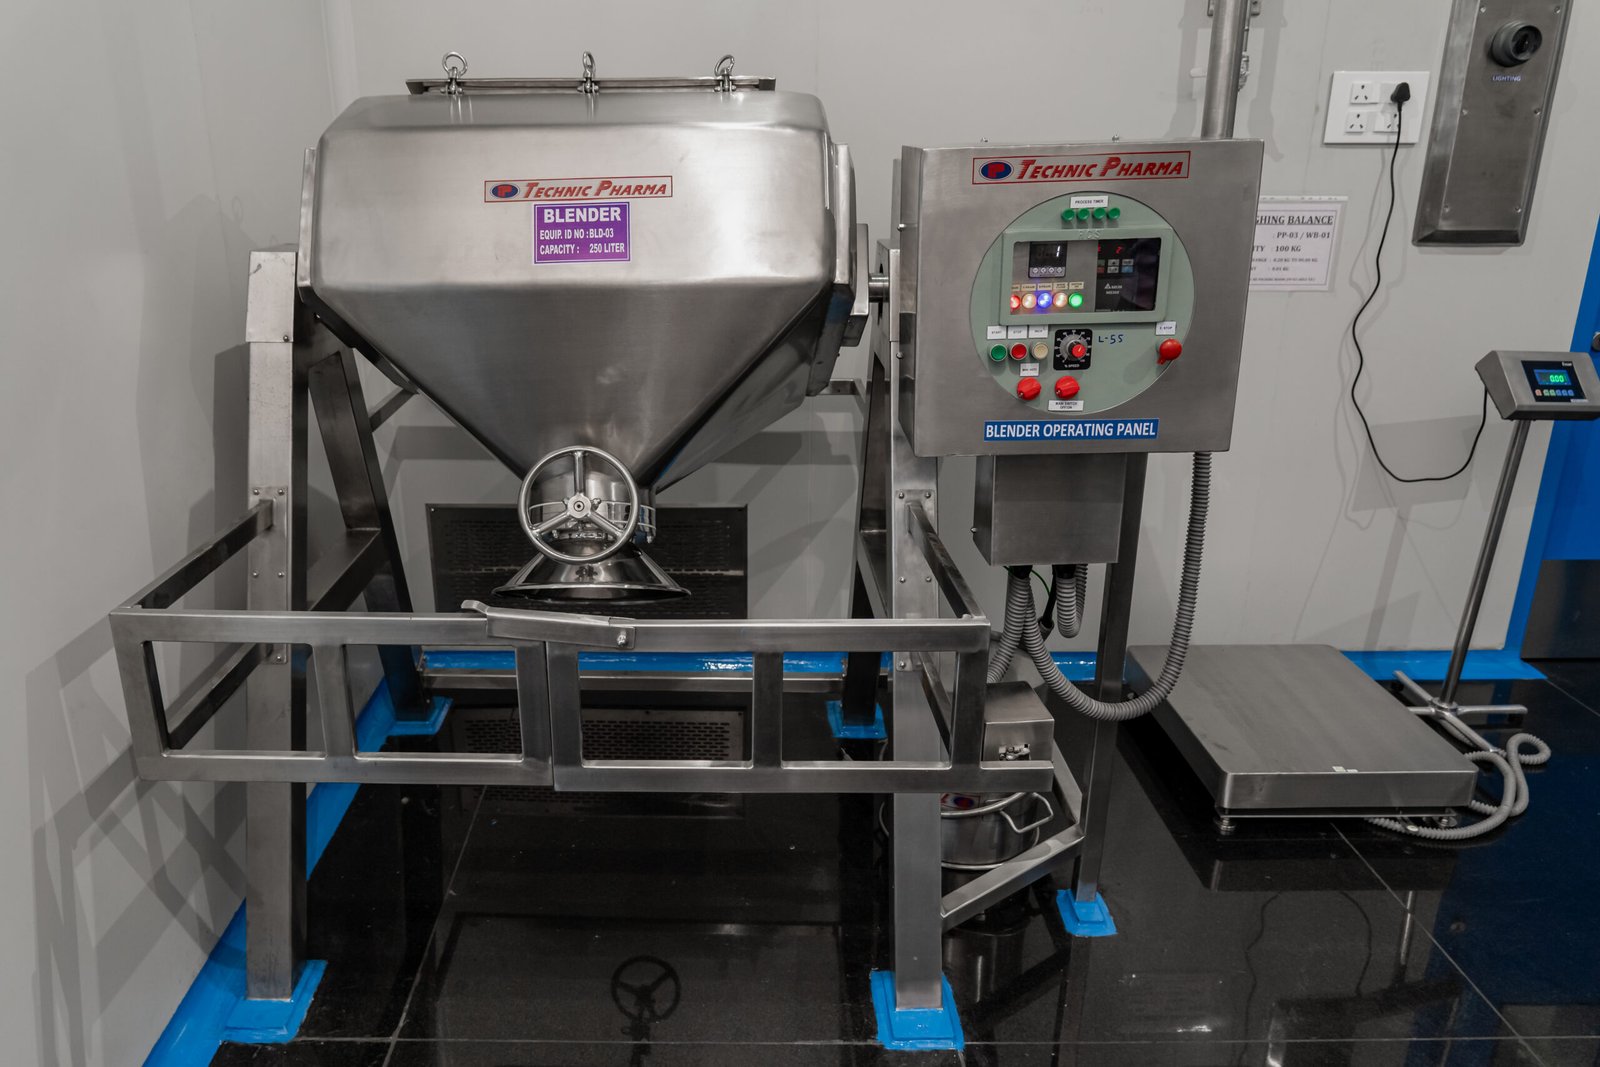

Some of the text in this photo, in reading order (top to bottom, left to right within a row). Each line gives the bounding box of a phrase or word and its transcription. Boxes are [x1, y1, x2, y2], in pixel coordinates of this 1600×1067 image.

[1016, 159, 1098, 180] TECHNIC
[1099, 156, 1184, 177] PHARMA
[523, 182, 592, 199] TECHNIC
[594, 180, 667, 197] PHARMA
[543, 207, 622, 223] BLENDER
[1287, 215, 1334, 225] BALANCE
[564, 229, 573, 239] ID
[573, 228, 585, 239] NO
[1276, 231, 1299, 239] PP-03
[1305, 231, 1331, 239] WB-01
[539, 244, 575, 255] CAPACITY
[589, 243, 603, 253] 250
[604, 242, 625, 253] LITER
[985, 422, 1156, 438] BLENDER OPERATING PANEL
